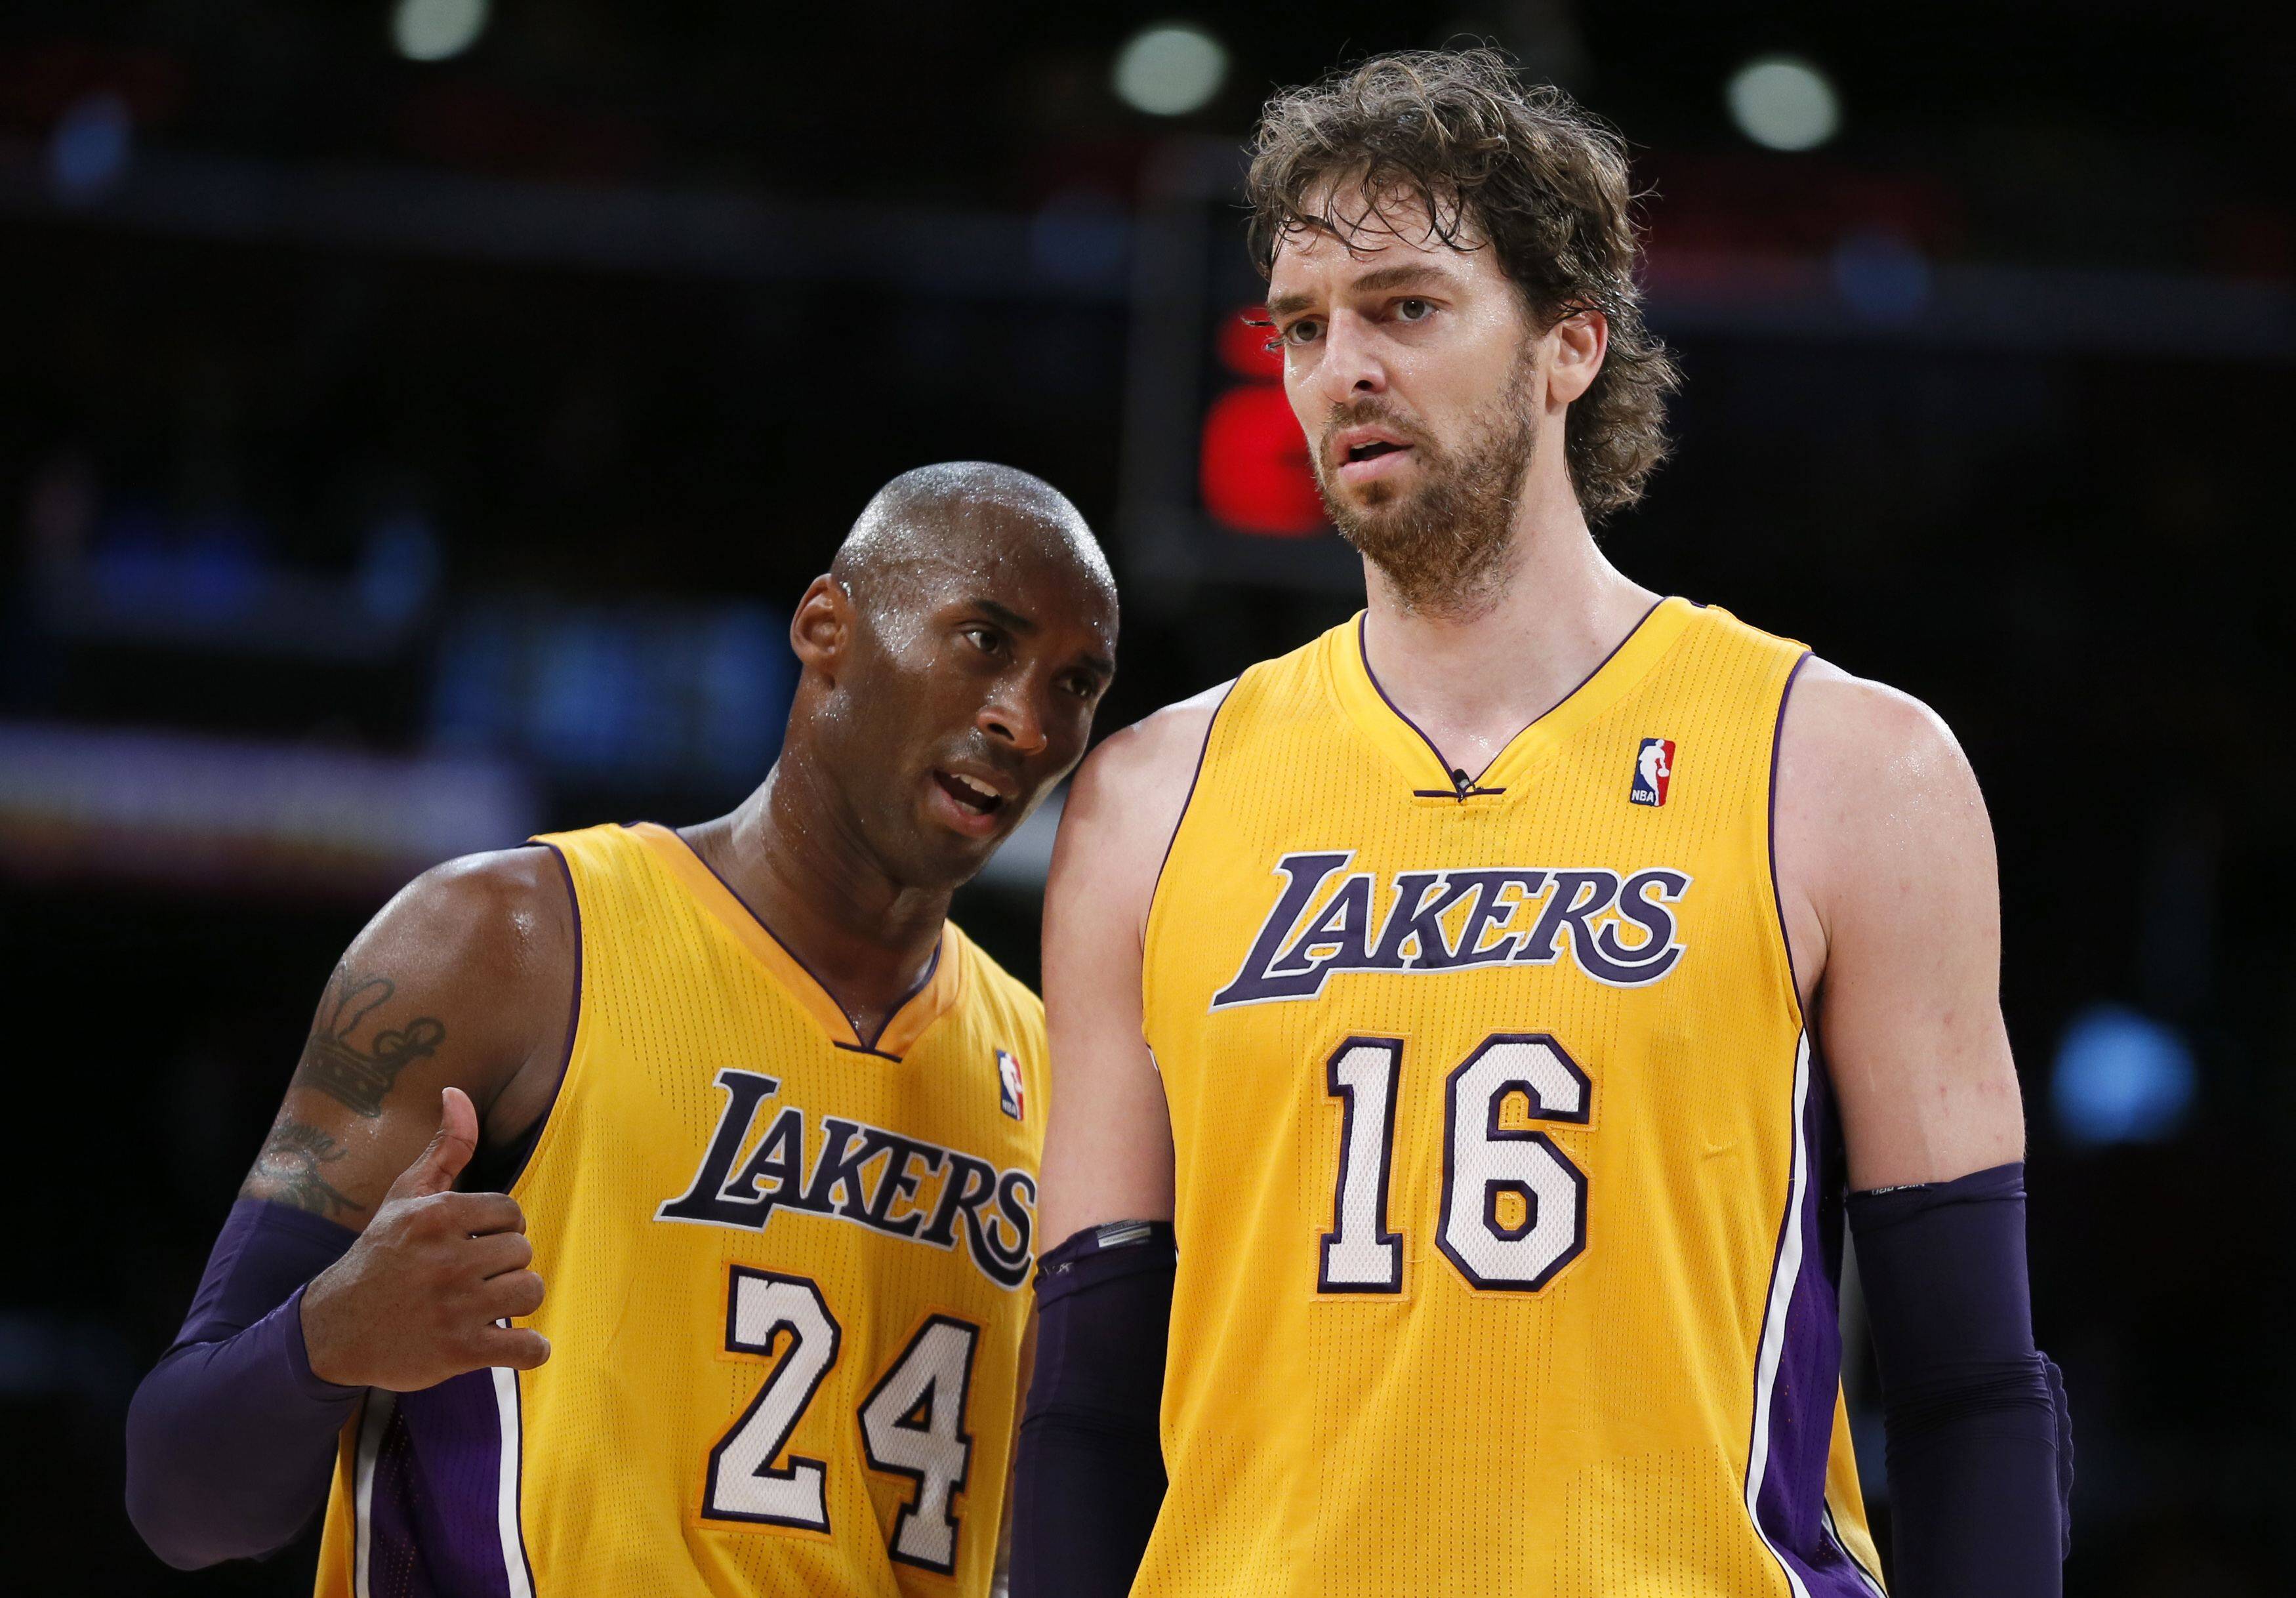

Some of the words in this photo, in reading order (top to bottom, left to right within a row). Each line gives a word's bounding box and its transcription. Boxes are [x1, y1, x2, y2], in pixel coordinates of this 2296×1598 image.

[1631, 789, 1654, 802] NBA
[1208, 850, 1693, 1014] LAKERS
[653, 1067, 1037, 1292] LAKERS
[1317, 1033, 1593, 1293] 16
[701, 1263, 981, 1576] 24
